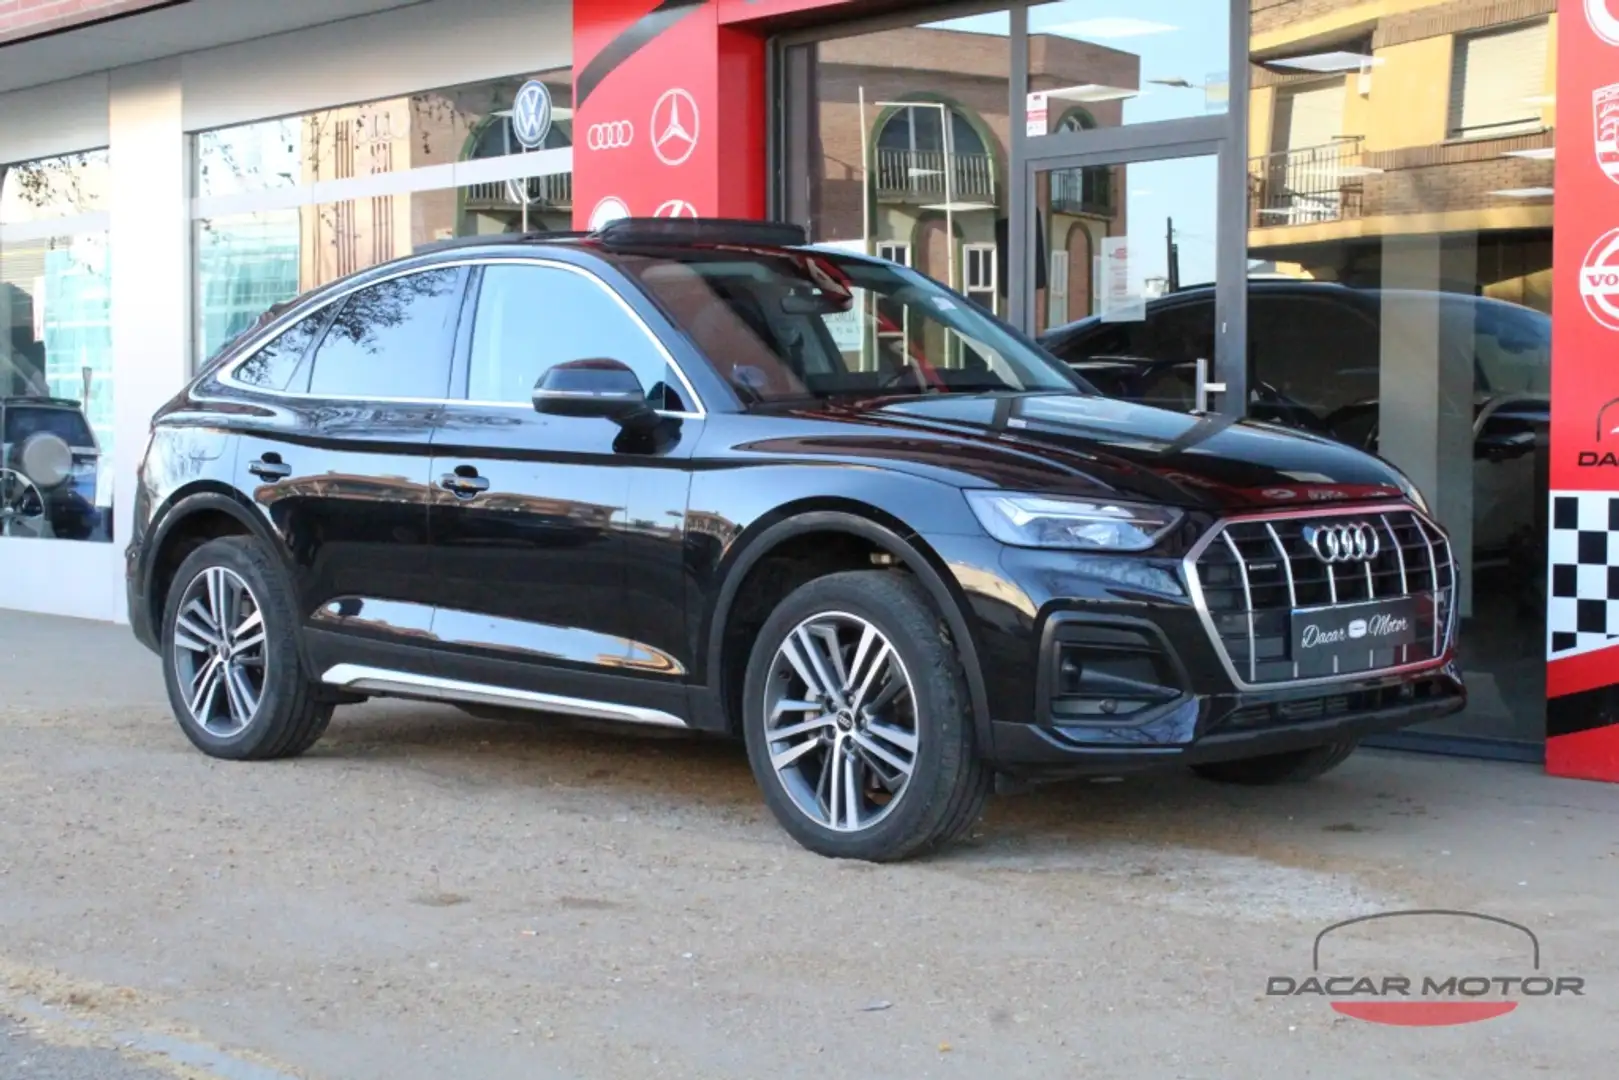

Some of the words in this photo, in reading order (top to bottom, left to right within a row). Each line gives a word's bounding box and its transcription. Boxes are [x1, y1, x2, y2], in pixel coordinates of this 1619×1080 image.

[1578, 451, 1619, 467] DA
[1301, 624, 1347, 649] Dacar
[1367, 612, 1409, 637] Motor
